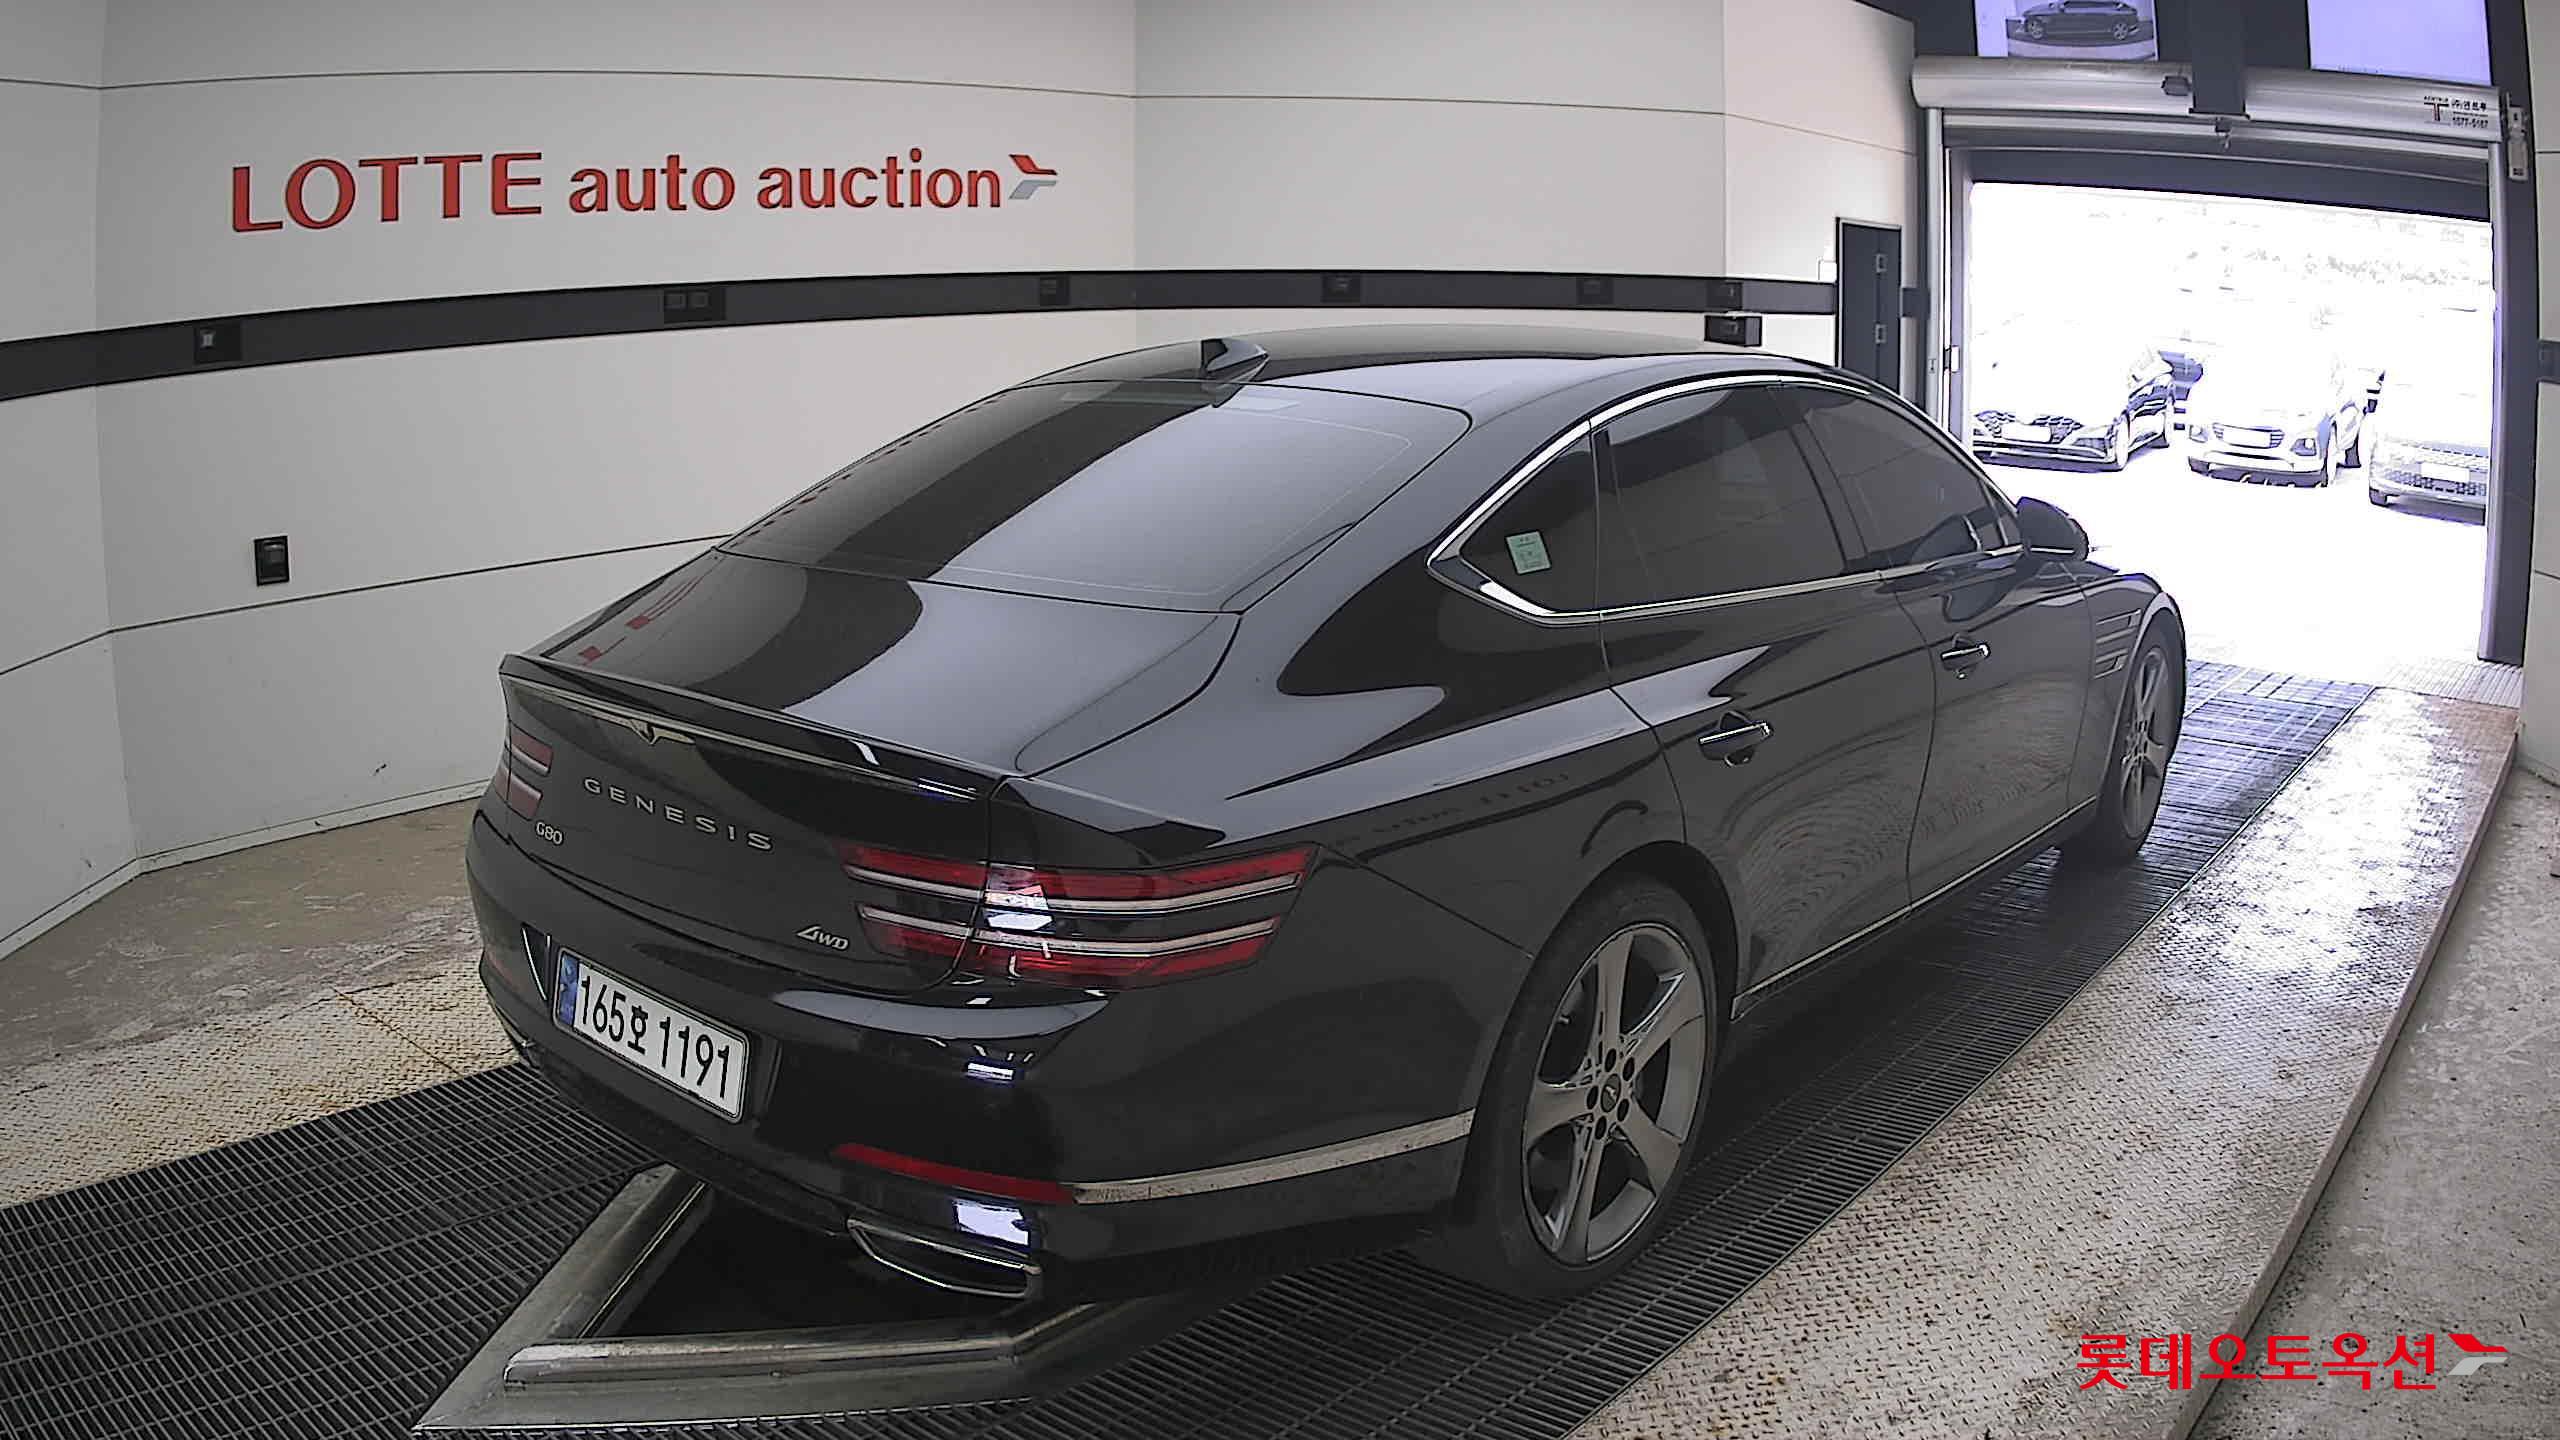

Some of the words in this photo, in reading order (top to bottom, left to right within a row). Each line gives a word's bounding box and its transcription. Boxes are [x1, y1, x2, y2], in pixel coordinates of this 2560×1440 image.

[231, 152, 543, 233] LOTTE
[568, 154, 736, 213] auto
[756, 147, 1001, 211] auction
[534, 821, 564, 846] G80
[583, 777, 772, 852] GENESIS
[796, 925, 850, 951] 4WD
[581, 975, 649, 1055] 165호
[659, 1016, 730, 1099] 1191
